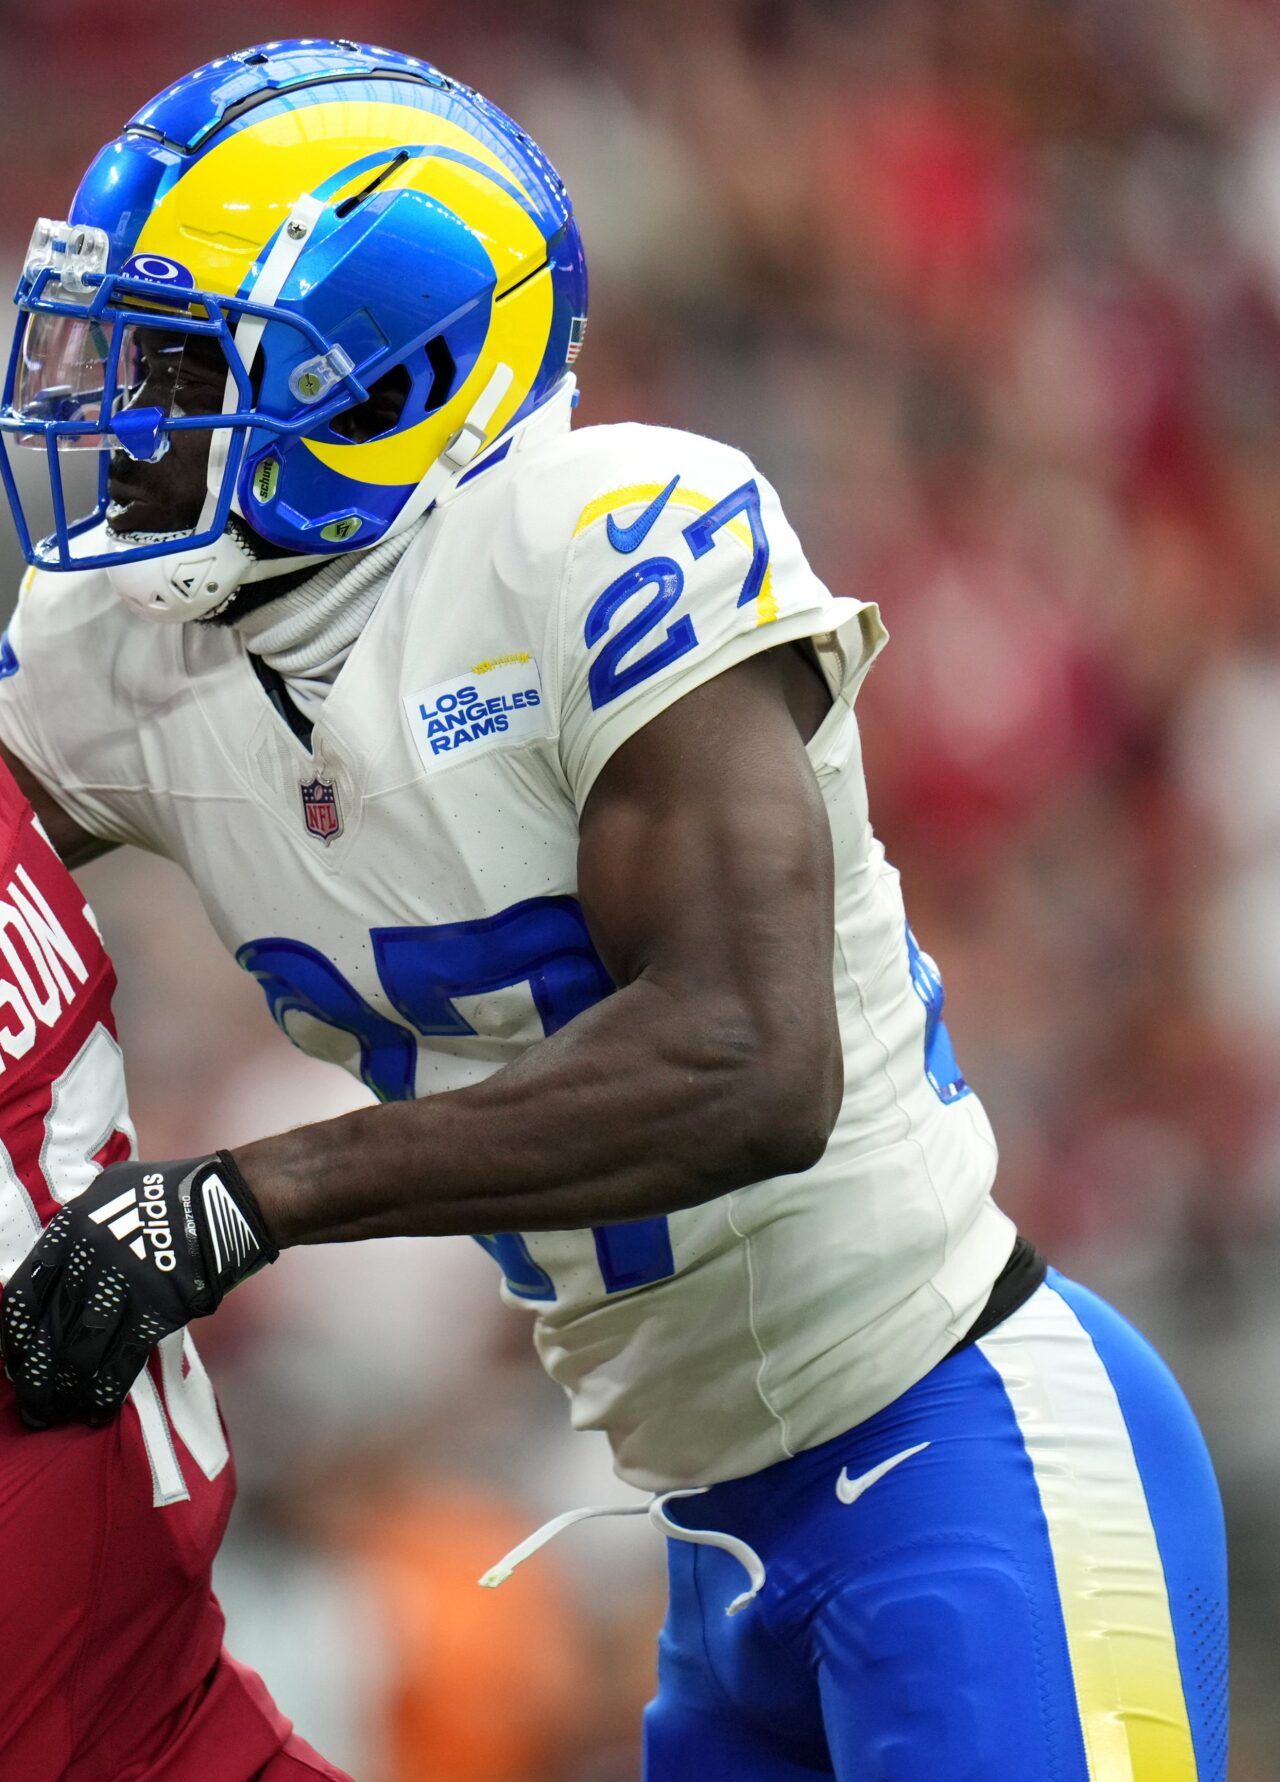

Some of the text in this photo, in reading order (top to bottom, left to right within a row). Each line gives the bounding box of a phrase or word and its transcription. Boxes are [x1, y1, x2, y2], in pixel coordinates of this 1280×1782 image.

[584, 478, 771, 711] 27
[419, 685, 479, 721] LOS
[427, 689, 541, 739] ANGELES
[430, 713, 509, 756] RAMS
[306, 803, 337, 832] NFL
[139, 1172, 177, 1273] adidas
